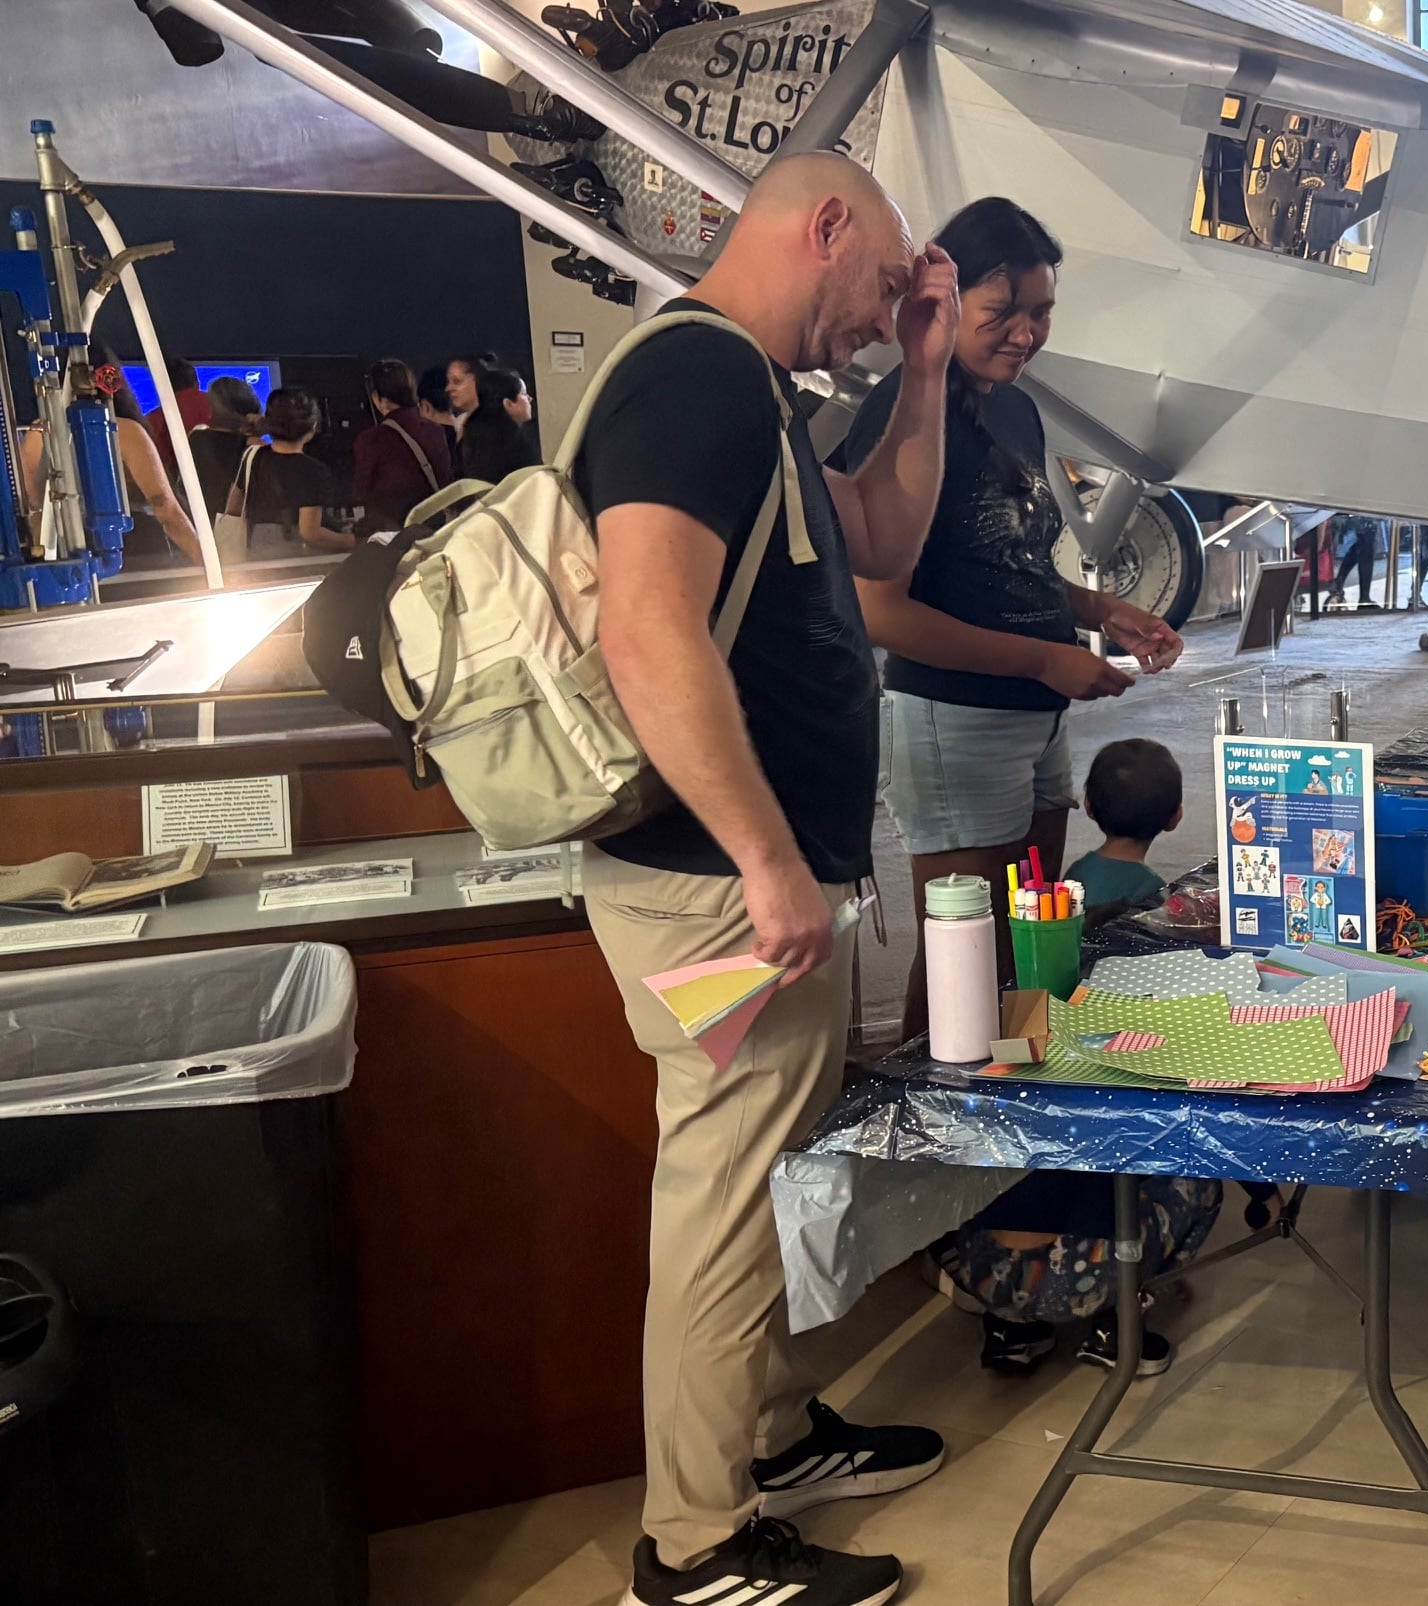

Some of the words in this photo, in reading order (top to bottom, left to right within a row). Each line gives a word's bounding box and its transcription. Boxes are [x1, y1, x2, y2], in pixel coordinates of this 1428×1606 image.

[704, 21, 852, 89] Spirit
[664, 79, 717, 141] St.
[775, 81, 815, 122] of
[1265, 748, 1269, 758] I
[1271, 749, 1302, 760] GROW
[1228, 775, 1260, 786] DRESS
[1261, 776, 1276, 786] UP
[1248, 762, 1290, 773] MAGNET
